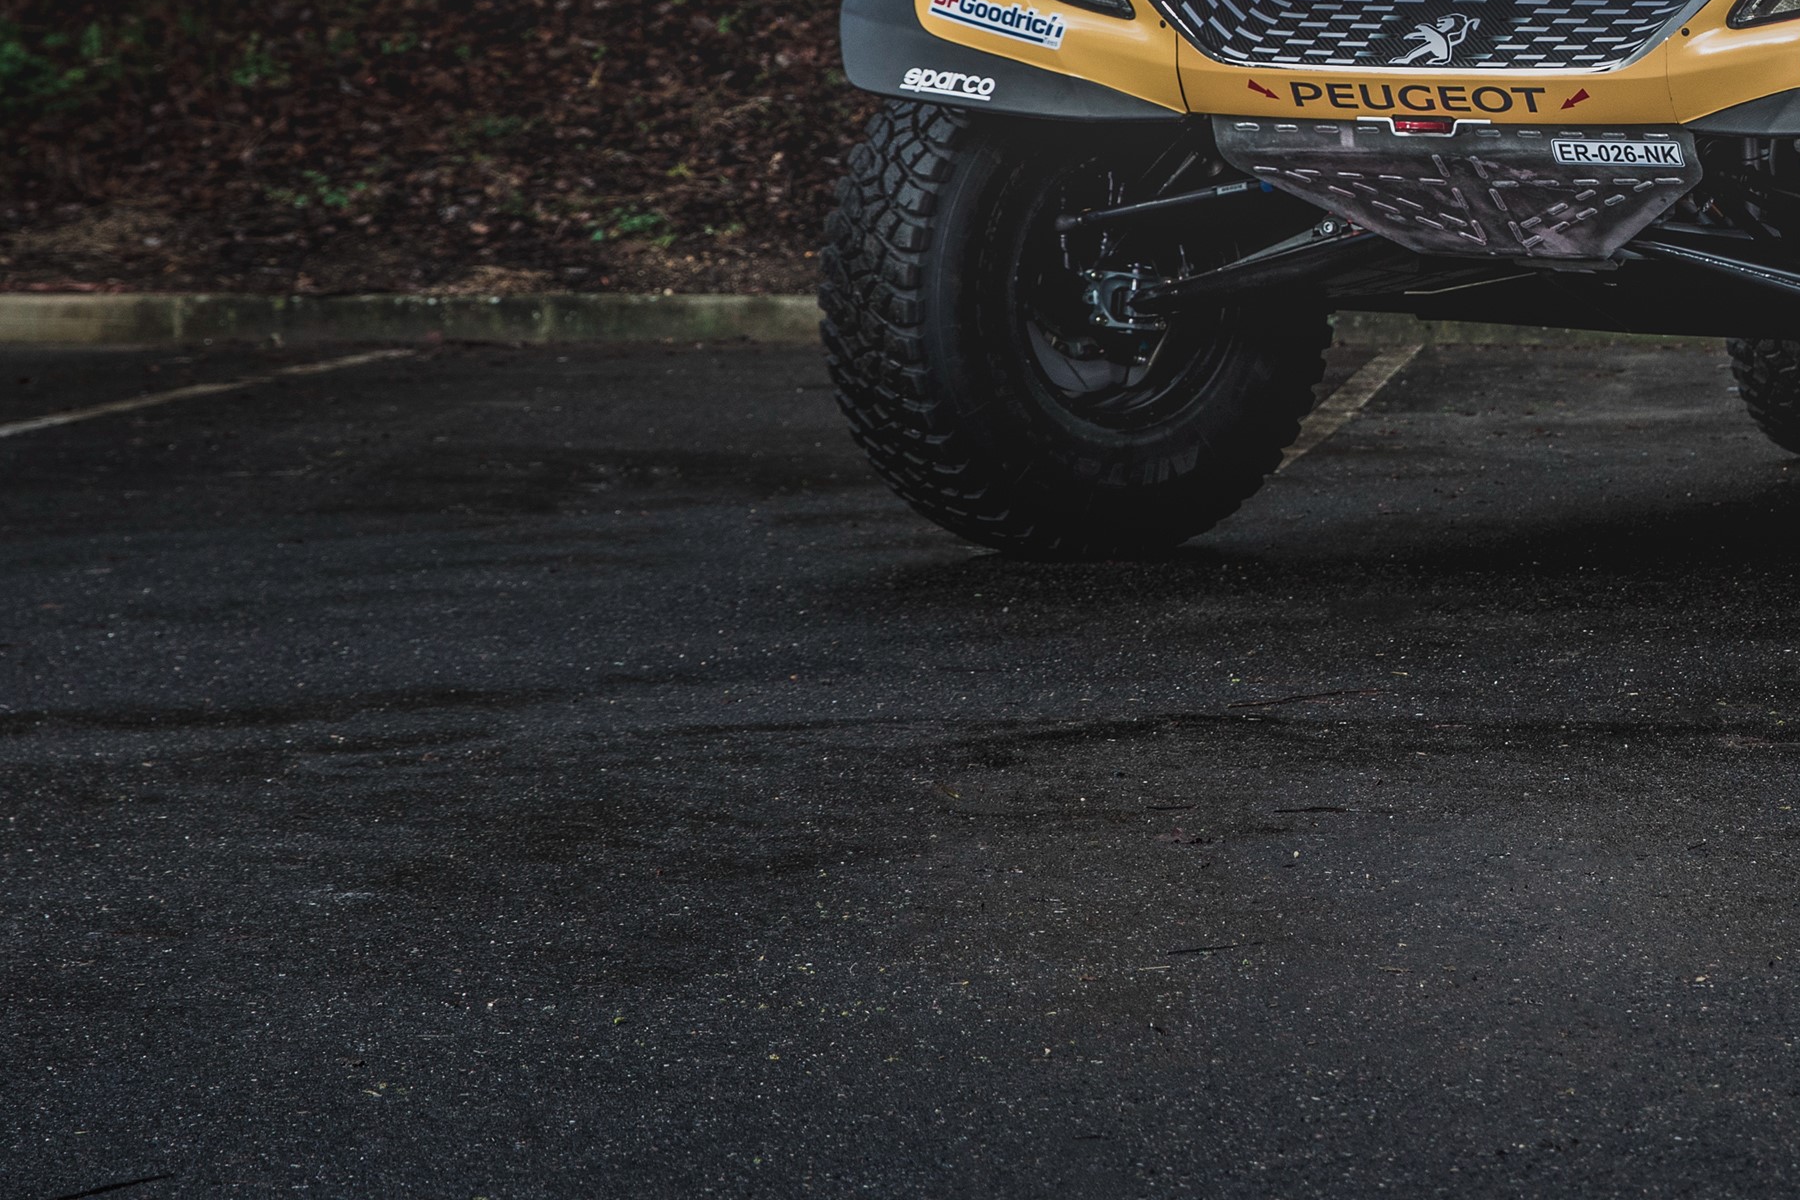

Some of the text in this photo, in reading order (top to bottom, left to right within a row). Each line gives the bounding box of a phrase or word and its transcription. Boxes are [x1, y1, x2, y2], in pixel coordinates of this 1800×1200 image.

[903, 67, 996, 97] sparco
[1289, 82, 1546, 113] PEUGEOT
[1557, 143, 1680, 164] ER-026-NK
